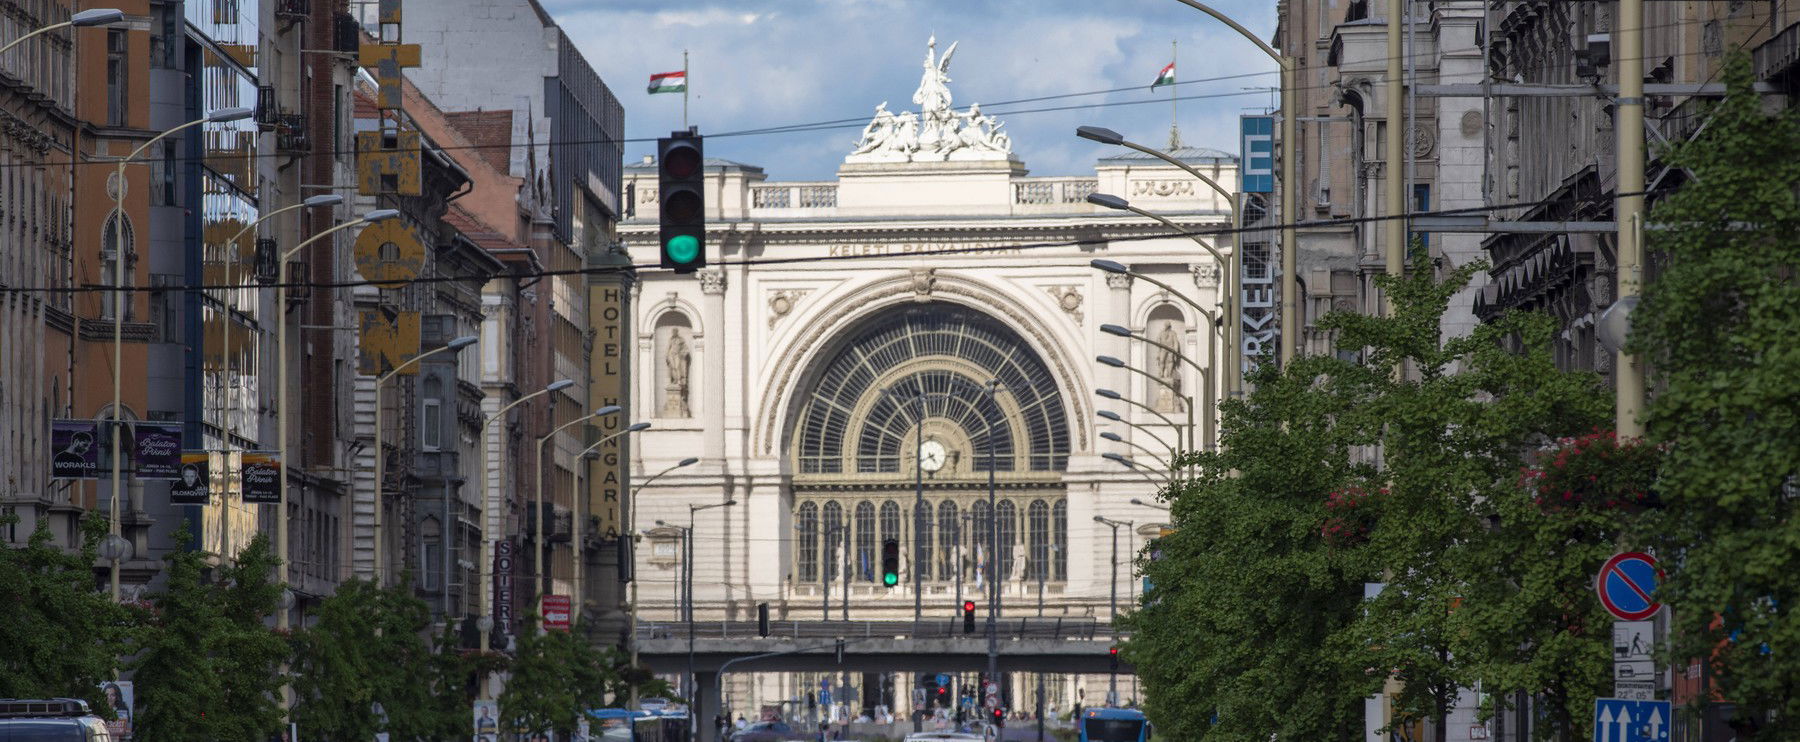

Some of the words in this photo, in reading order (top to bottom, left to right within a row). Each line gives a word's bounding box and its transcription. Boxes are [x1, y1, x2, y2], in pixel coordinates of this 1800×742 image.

[829, 244, 891, 257] KELETI
[603, 288, 619, 376] HOTEL
[54, 461, 97, 469] WORAKLS
[603, 397, 618, 539] HUNGARIA
